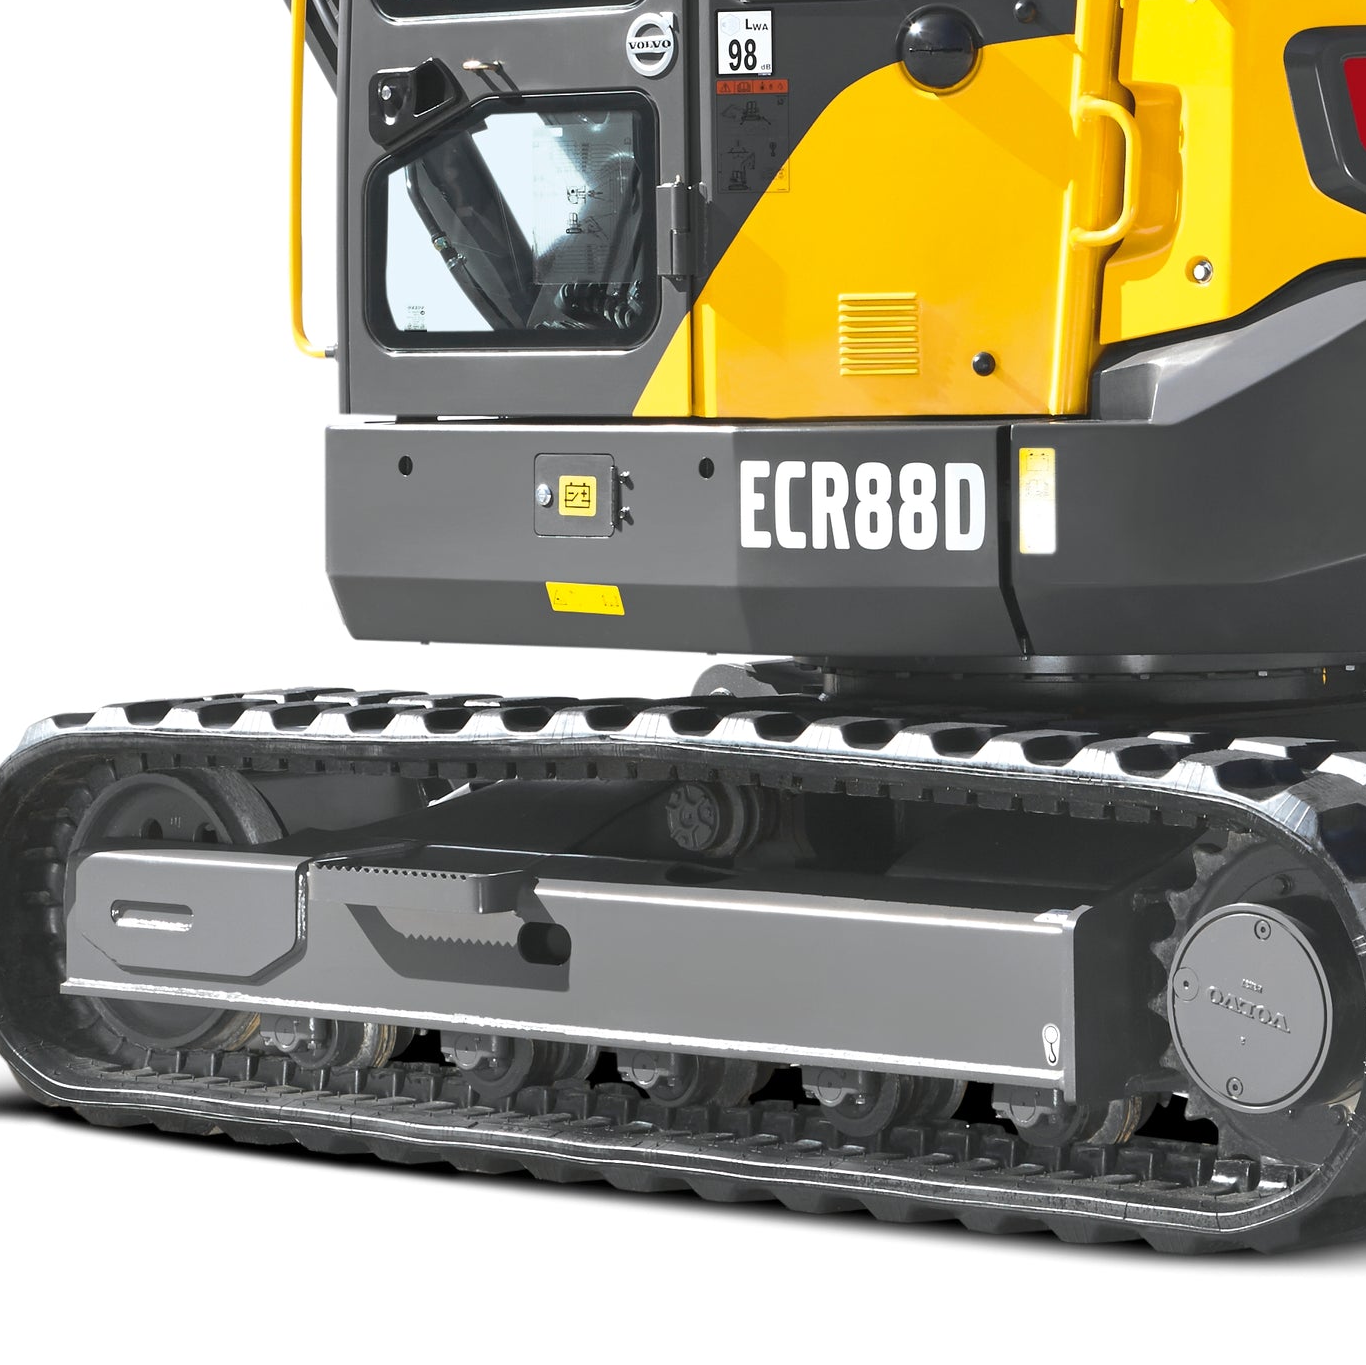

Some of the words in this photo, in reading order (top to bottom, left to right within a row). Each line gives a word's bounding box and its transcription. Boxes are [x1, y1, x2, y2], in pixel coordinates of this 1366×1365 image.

[745, 18, 769, 31] LWA
[628, 39, 672, 50] VOLVO
[728, 38, 757, 71] 98
[760, 63, 772, 71] dB
[740, 460, 986, 552] ECR88D
